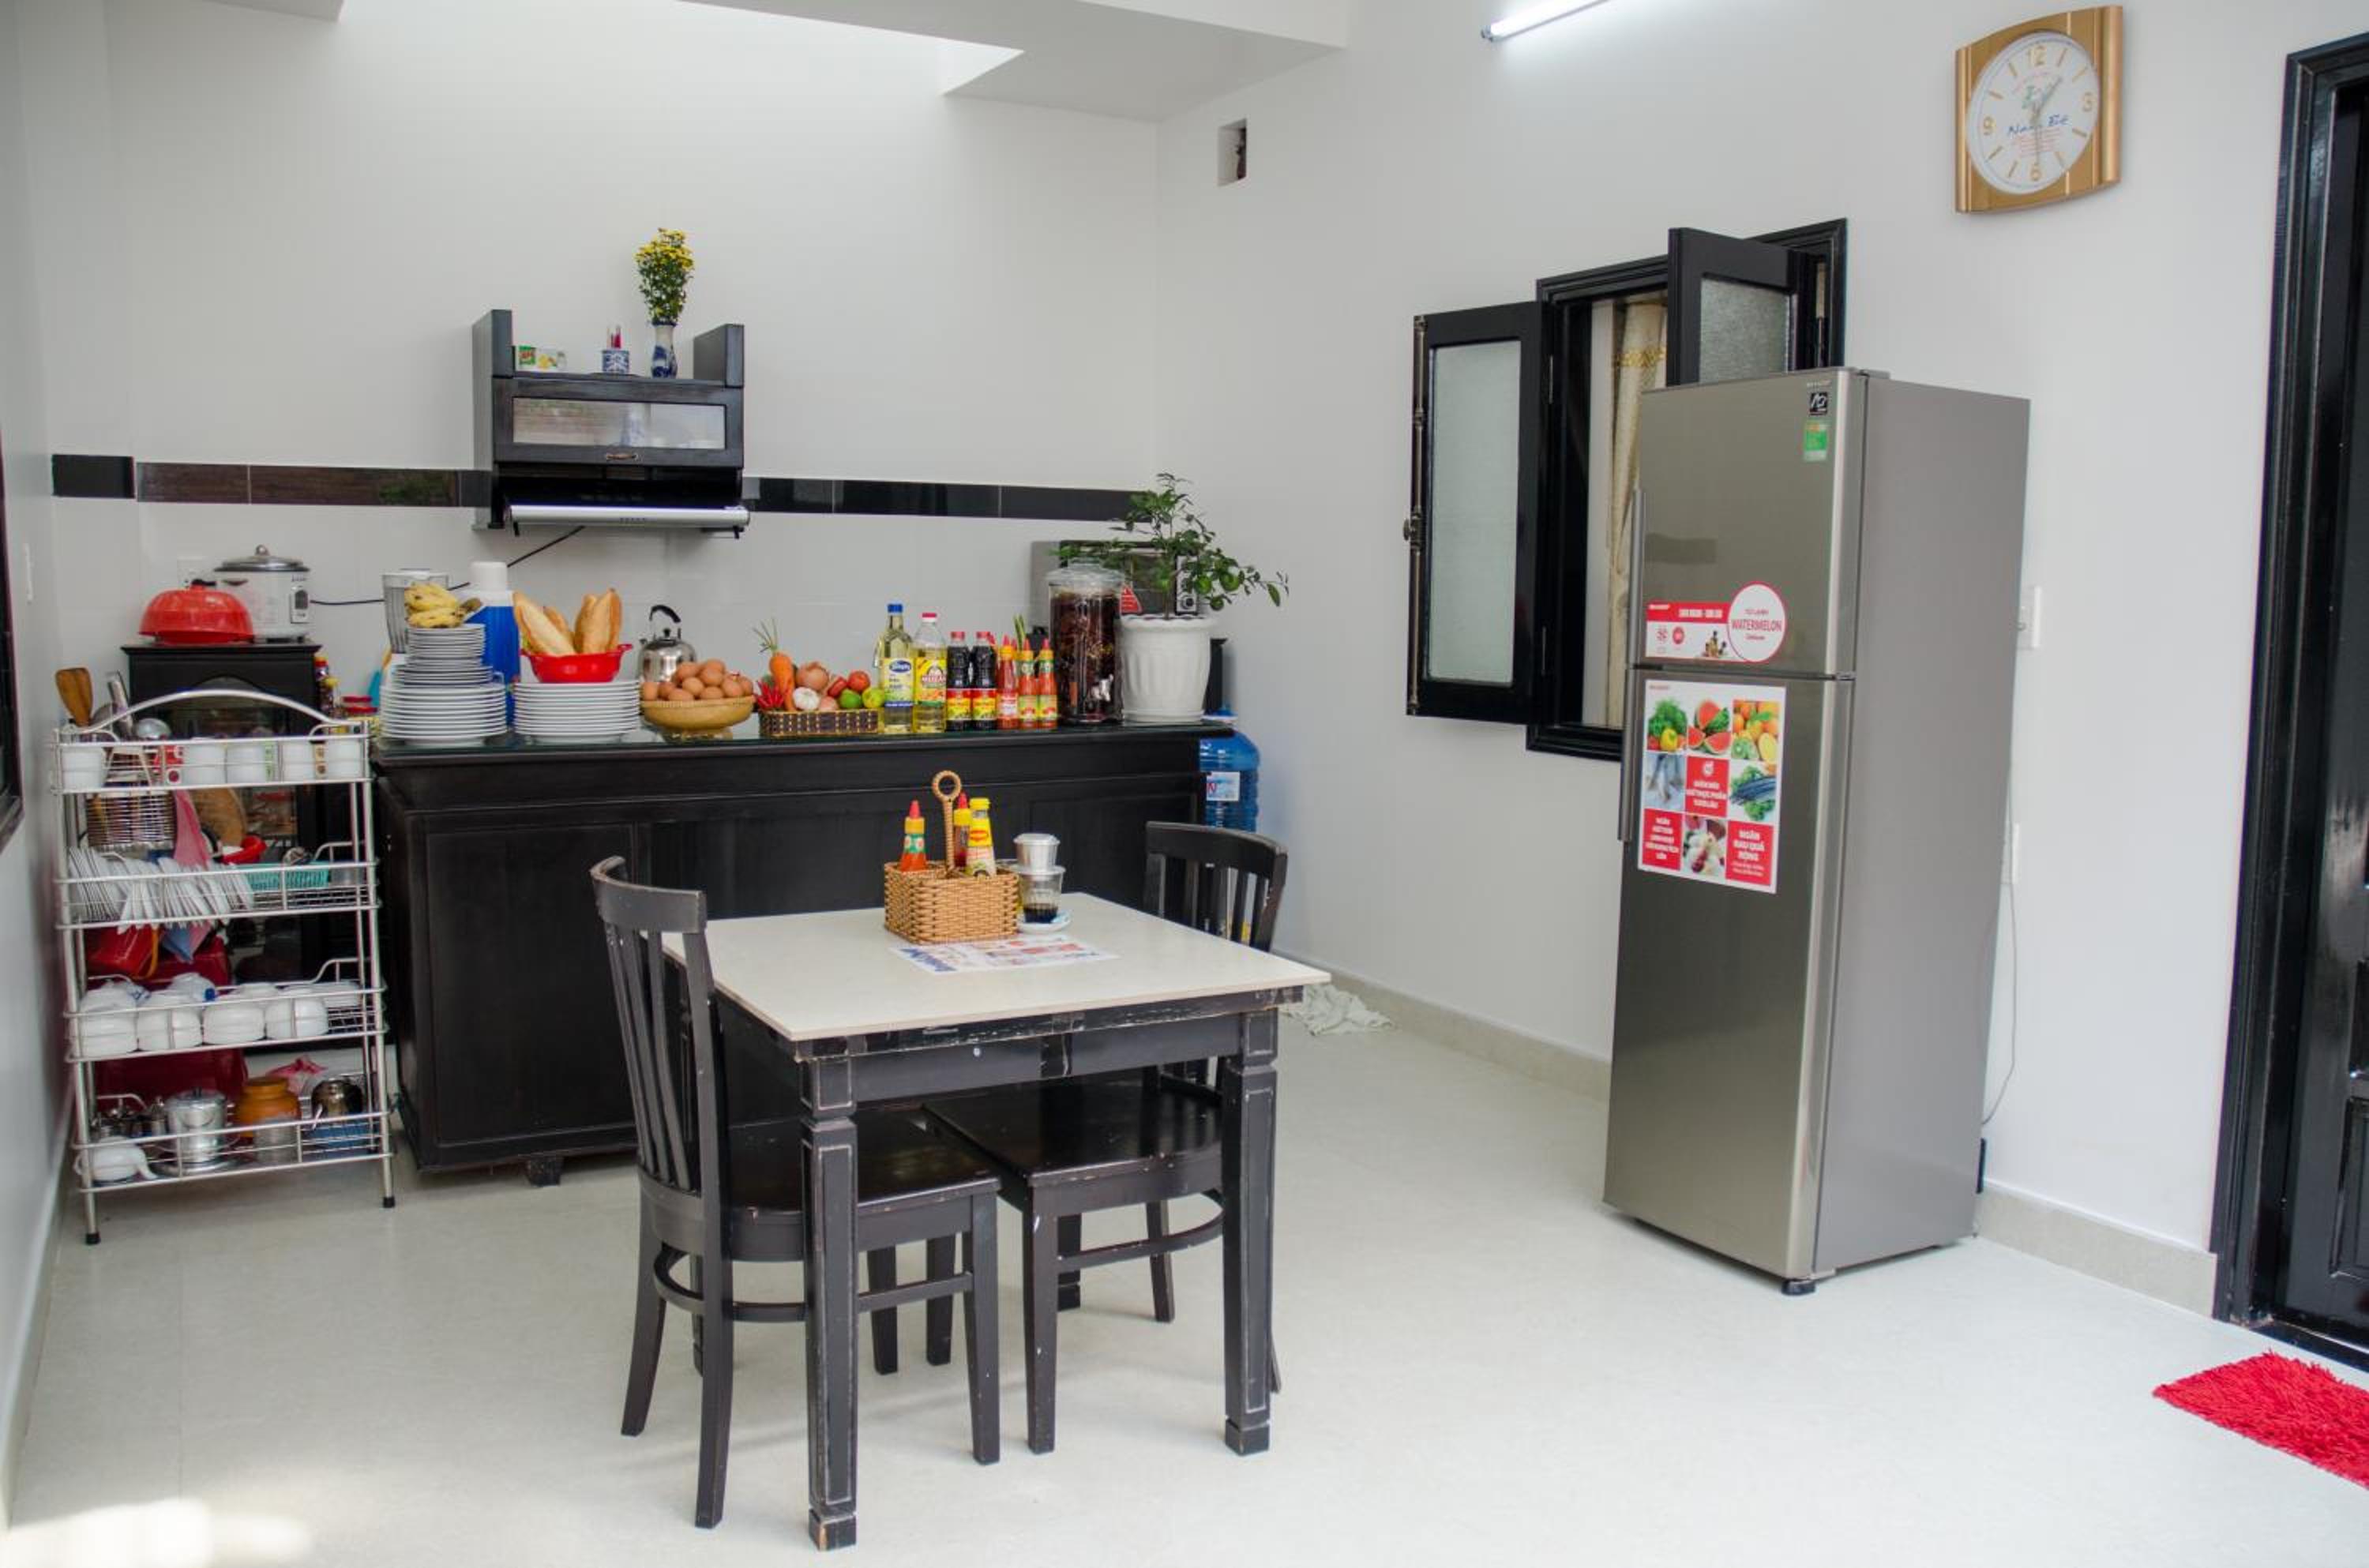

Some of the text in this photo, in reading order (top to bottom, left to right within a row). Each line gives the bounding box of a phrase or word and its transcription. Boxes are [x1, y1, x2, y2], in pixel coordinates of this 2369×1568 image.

[2027, 45, 2047, 66] 12
[2082, 91, 2093, 112] 3
[1984, 116, 1994, 136] 9
[2030, 163, 2042, 181] 6
[1732, 618, 1782, 632] WATERMELON
